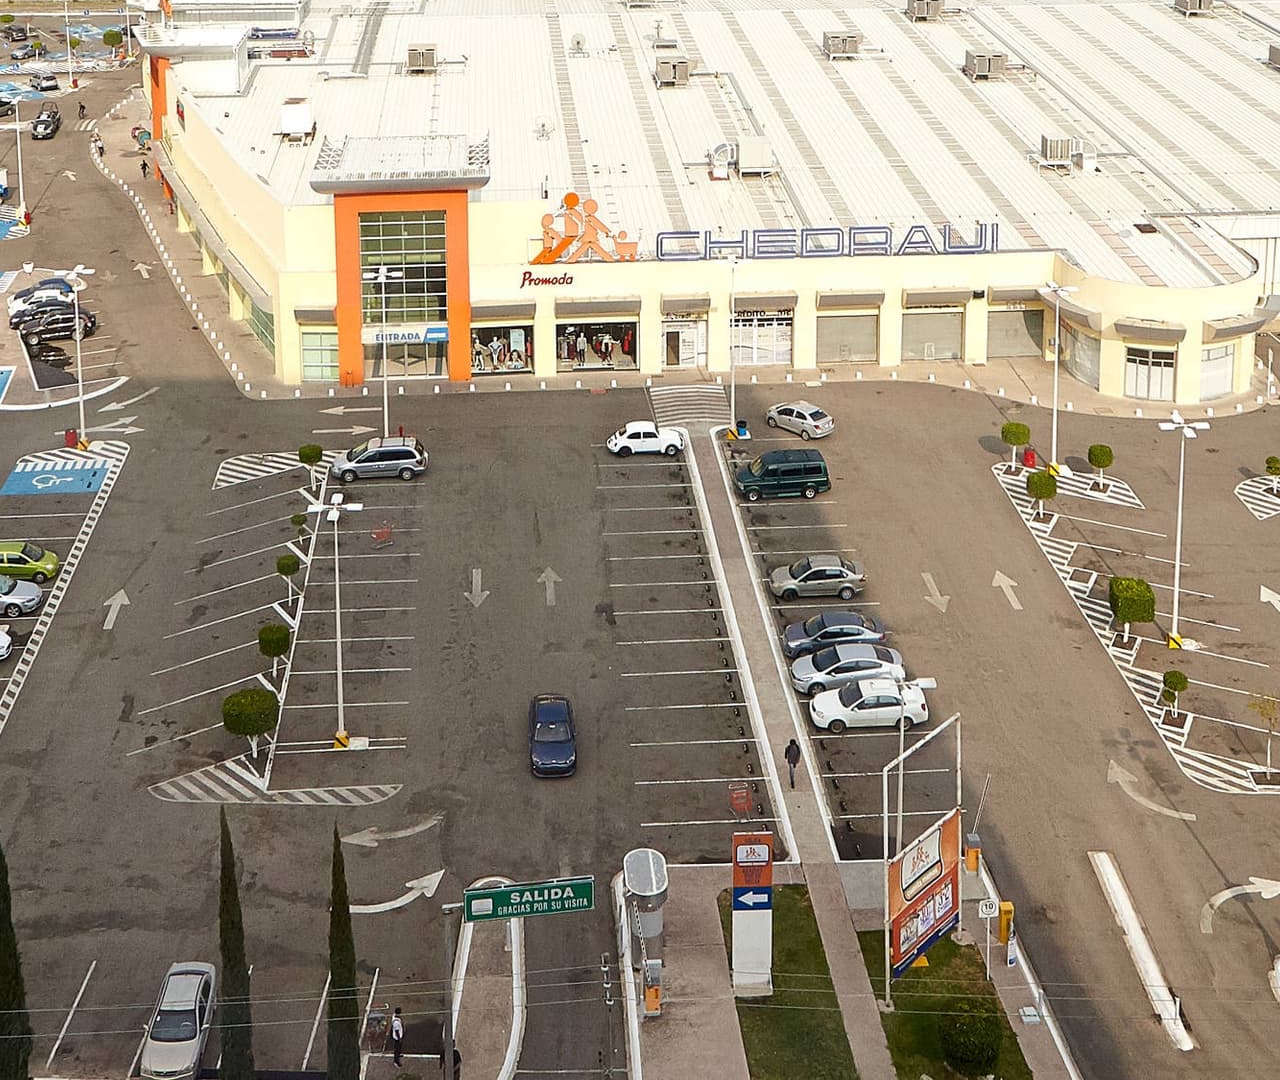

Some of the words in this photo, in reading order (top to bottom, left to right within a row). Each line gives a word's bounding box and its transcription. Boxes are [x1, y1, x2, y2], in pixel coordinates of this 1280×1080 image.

[656, 223, 1000, 260] CHEDRAUI
[520, 271, 574, 288] Promoda
[376, 332, 421, 342] ENTRADA
[510, 887, 575, 903] SALIDA
[498, 903, 531, 916] GRACIAS
[533, 901, 548, 912] POR
[551, 900, 562, 910] SU
[564, 898, 589, 909] VISITA
